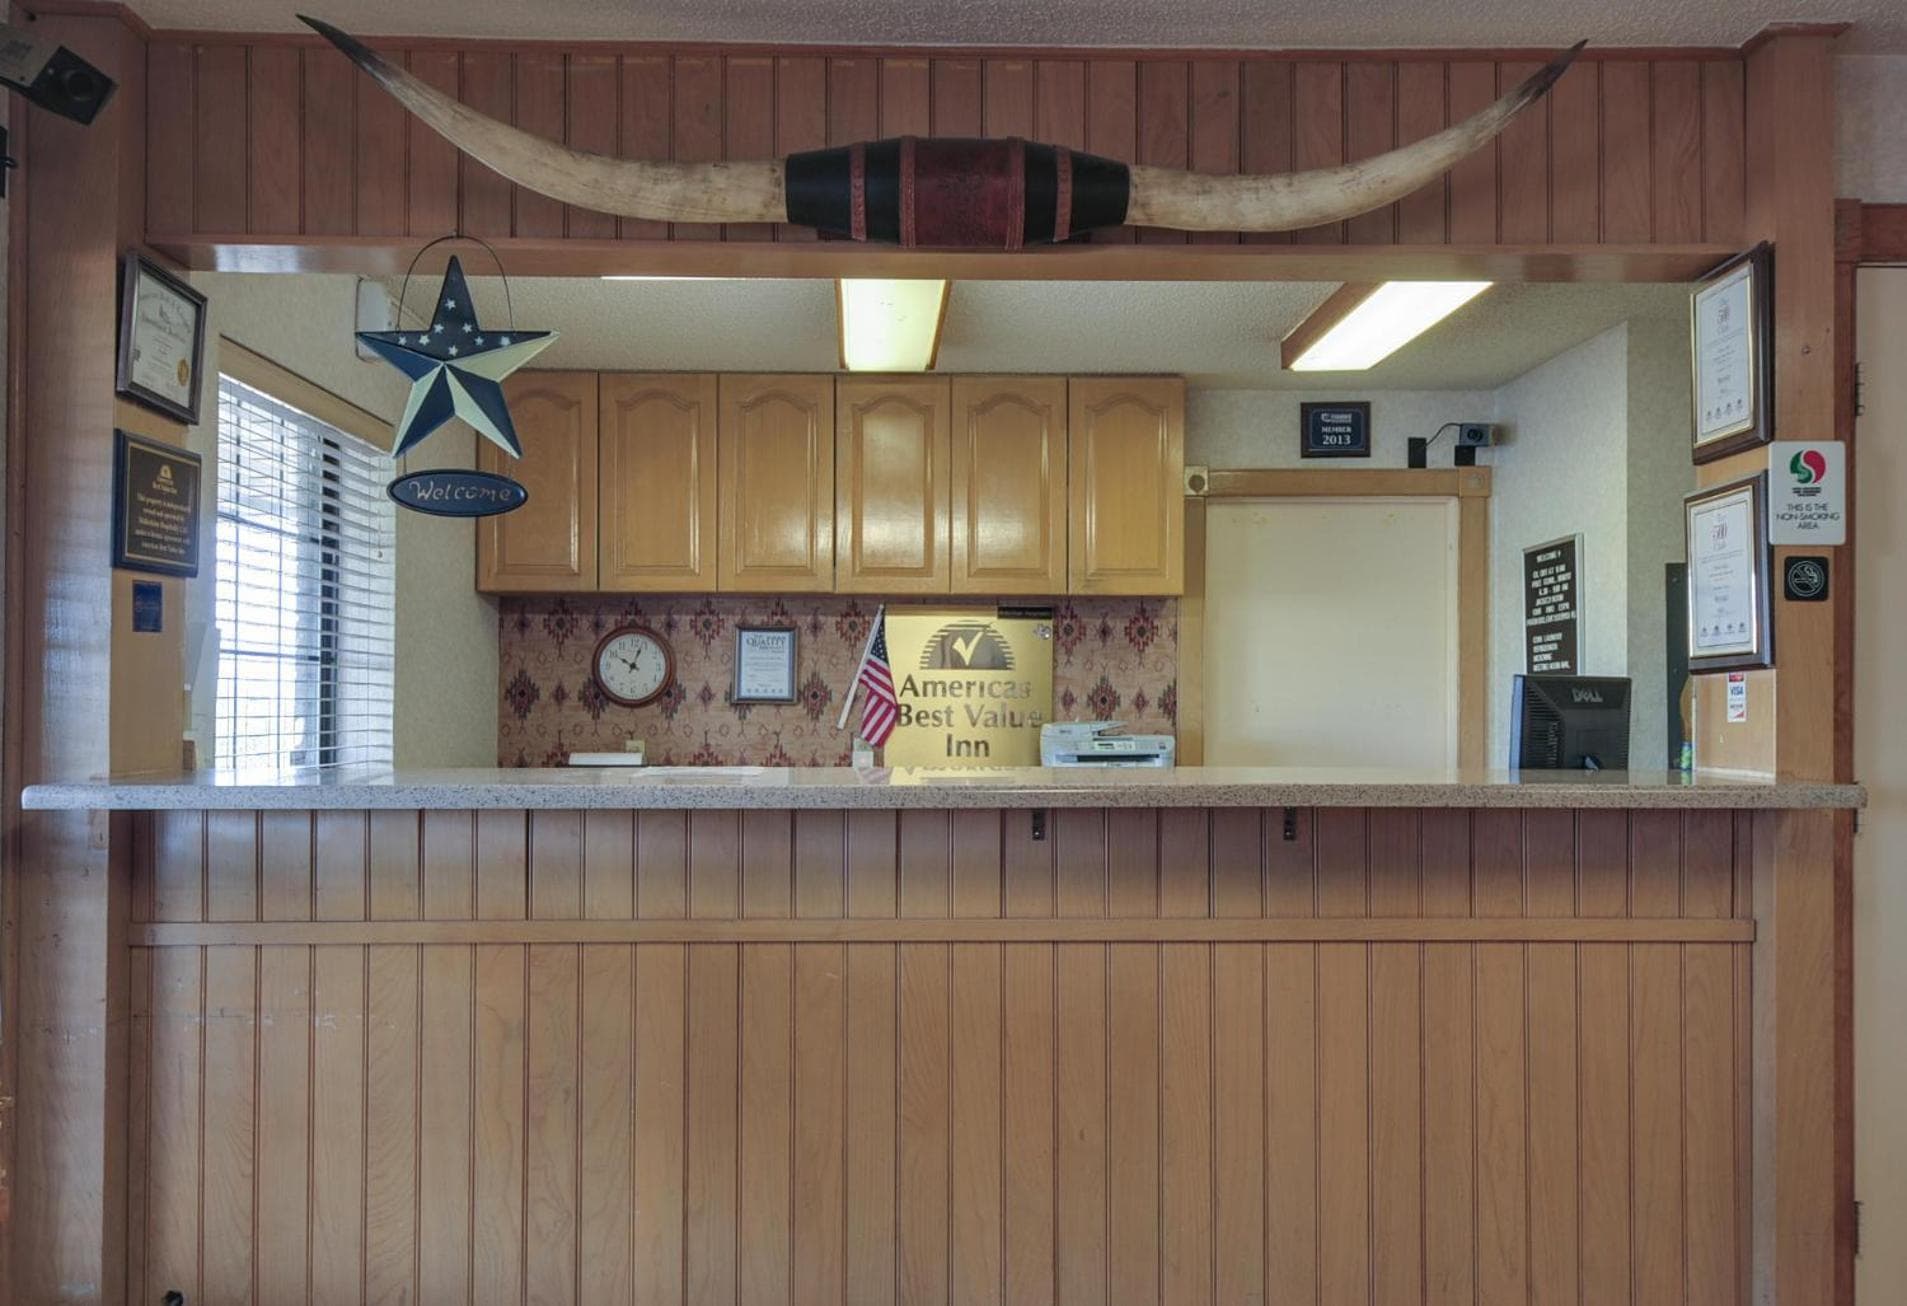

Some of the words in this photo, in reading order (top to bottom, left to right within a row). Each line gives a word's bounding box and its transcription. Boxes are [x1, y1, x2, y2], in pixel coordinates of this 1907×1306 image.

[1322, 434, 1351, 445] 2013
[409, 480, 510, 501] Welcome
[1787, 503, 1803, 512] THIS
[1805, 503, 1813, 512] IS
[1814, 503, 1828, 512] THE
[1797, 522, 1819, 530] AREA
[899, 673, 1032, 699] Americas
[1730, 686, 1744, 696] VISA
[1572, 688, 1604, 703] DELL
[897, 702, 955, 728] Best
[963, 702, 1043, 729] Value
[945, 733, 991, 758] Inn
